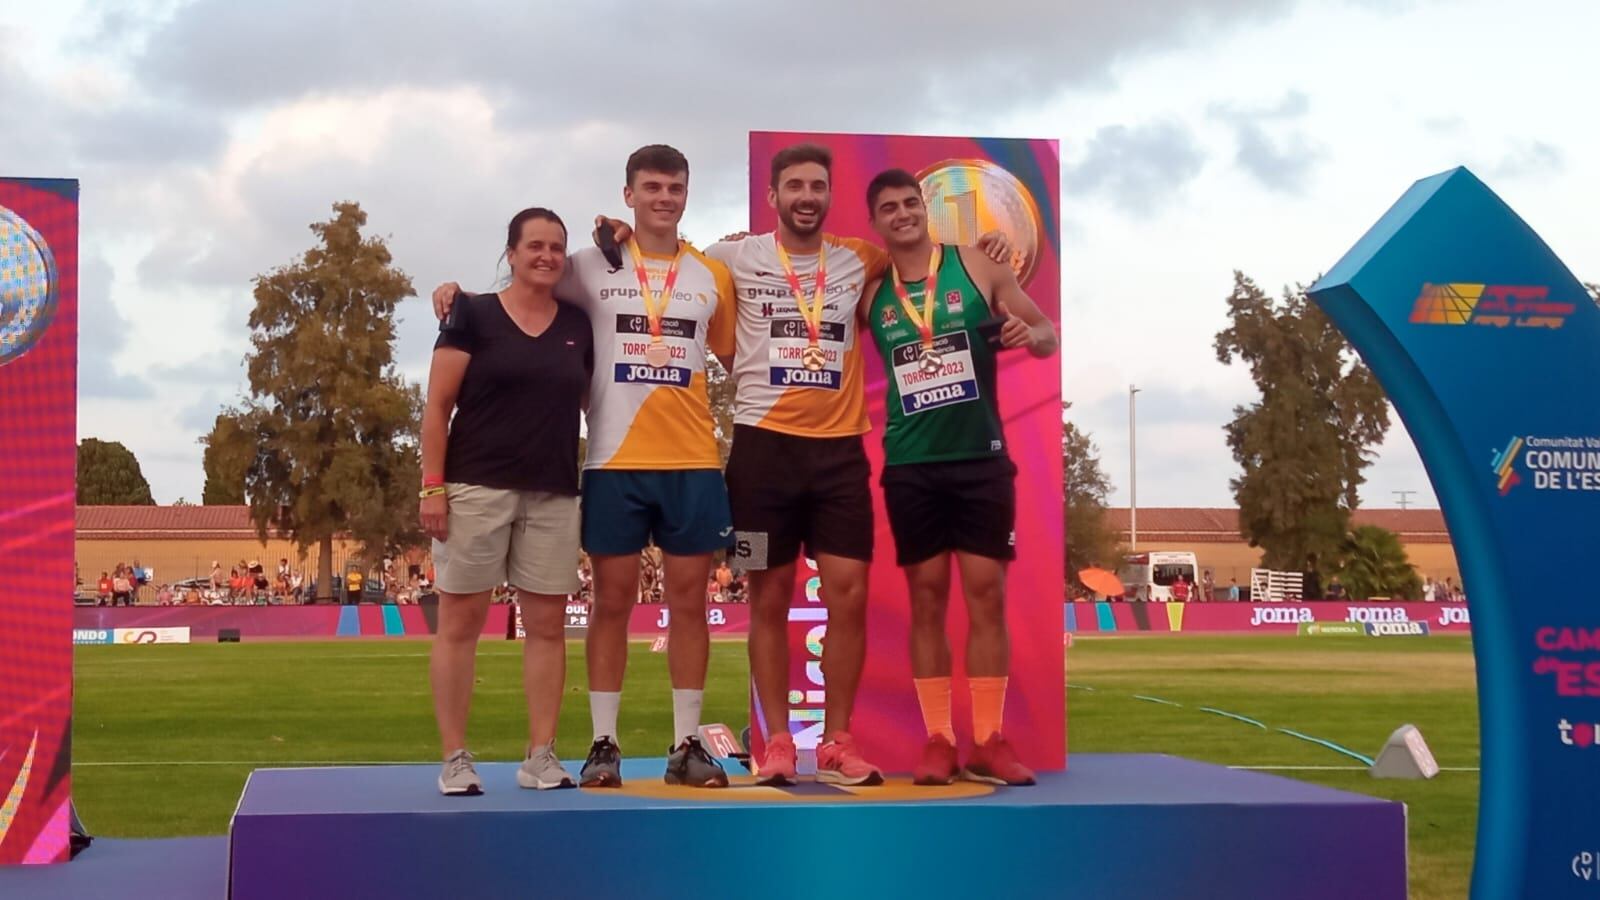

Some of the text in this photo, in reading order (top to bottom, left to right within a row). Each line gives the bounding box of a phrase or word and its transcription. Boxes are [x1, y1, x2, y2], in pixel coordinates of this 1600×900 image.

[665, 346, 686, 360] 023
[941, 361, 964, 376] 2023
[1526, 435, 1585, 448] Comunitat
[1535, 471, 1561, 489] DE
